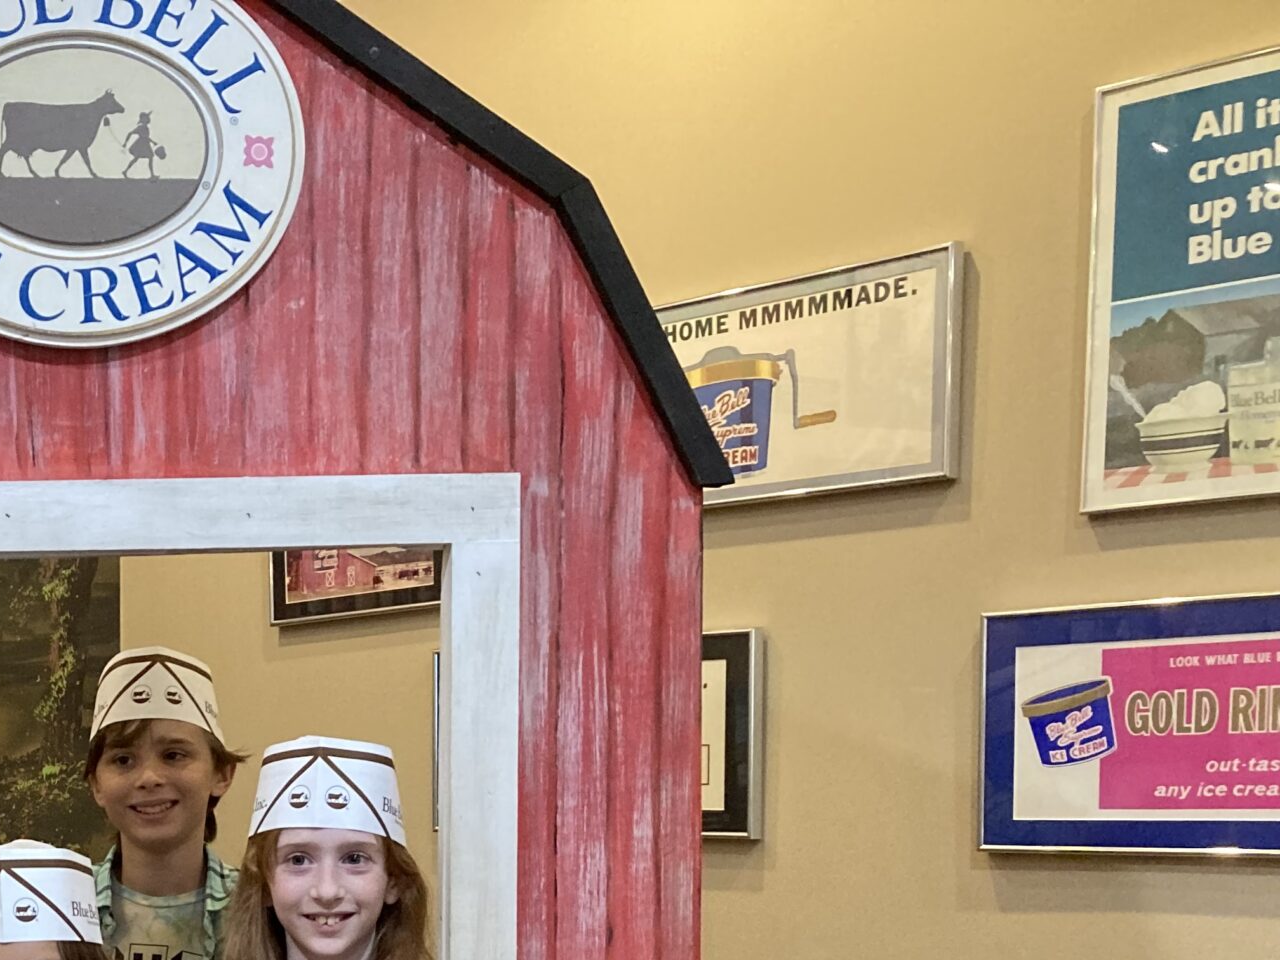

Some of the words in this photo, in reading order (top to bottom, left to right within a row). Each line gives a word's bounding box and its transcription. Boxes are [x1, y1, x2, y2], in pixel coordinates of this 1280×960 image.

[93, 0, 266, 115] BELL
[1192, 102, 1244, 142] All
[1188, 196, 1237, 228] up
[1247, 186, 1280, 213] to
[19, 180, 273, 325] CREAM
[1188, 229, 1273, 265] Blue
[664, 314, 729, 343] HOME
[739, 276, 918, 330] MMMMMADE.
[715, 387, 751, 419] Bell
[724, 447, 758, 467] REAM
[1169, 656, 1199, 668] LOOK
[1205, 653, 1237, 666] WHAT
[1243, 652, 1271, 664] BLUE
[1125, 688, 1219, 736] GOLD
[1154, 784, 1191, 800] any
[1197, 782, 1227, 797] ice
[71, 901, 89, 918] Blue
